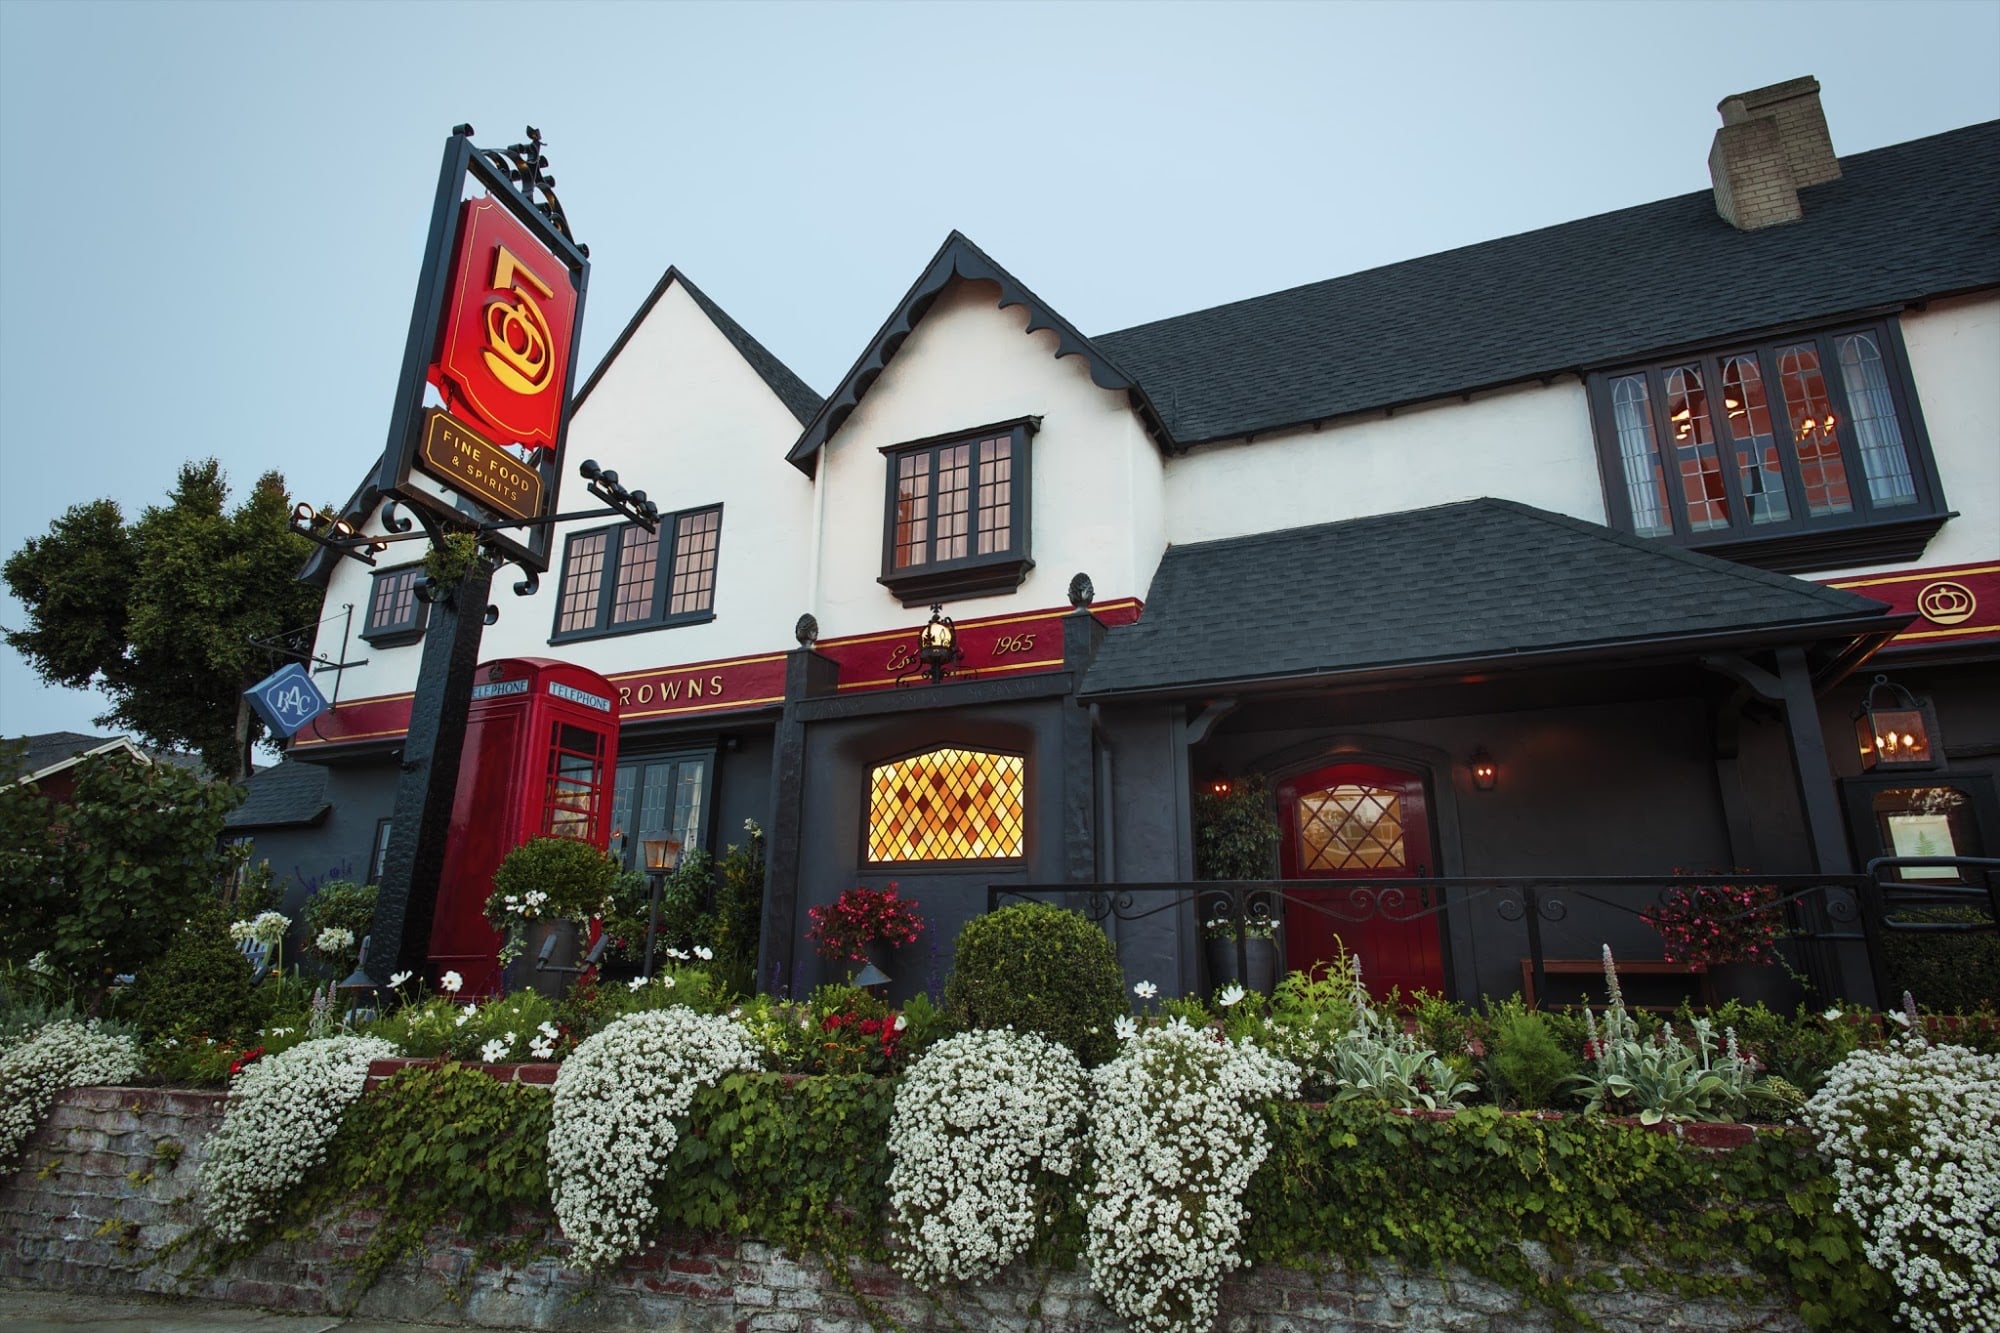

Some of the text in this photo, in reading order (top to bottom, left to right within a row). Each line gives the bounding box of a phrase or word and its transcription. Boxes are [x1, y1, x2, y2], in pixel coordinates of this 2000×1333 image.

[443, 430, 529, 492] FINE FOOD
[451, 455, 517, 501] & SPIRITS
[991, 634, 1036, 656] 1965
[277, 685, 311, 716] RAC
[472, 680, 528, 698] ELEPHONE
[551, 683, 609, 711] TELEPHONE
[619, 675, 723, 705] ROWNS
